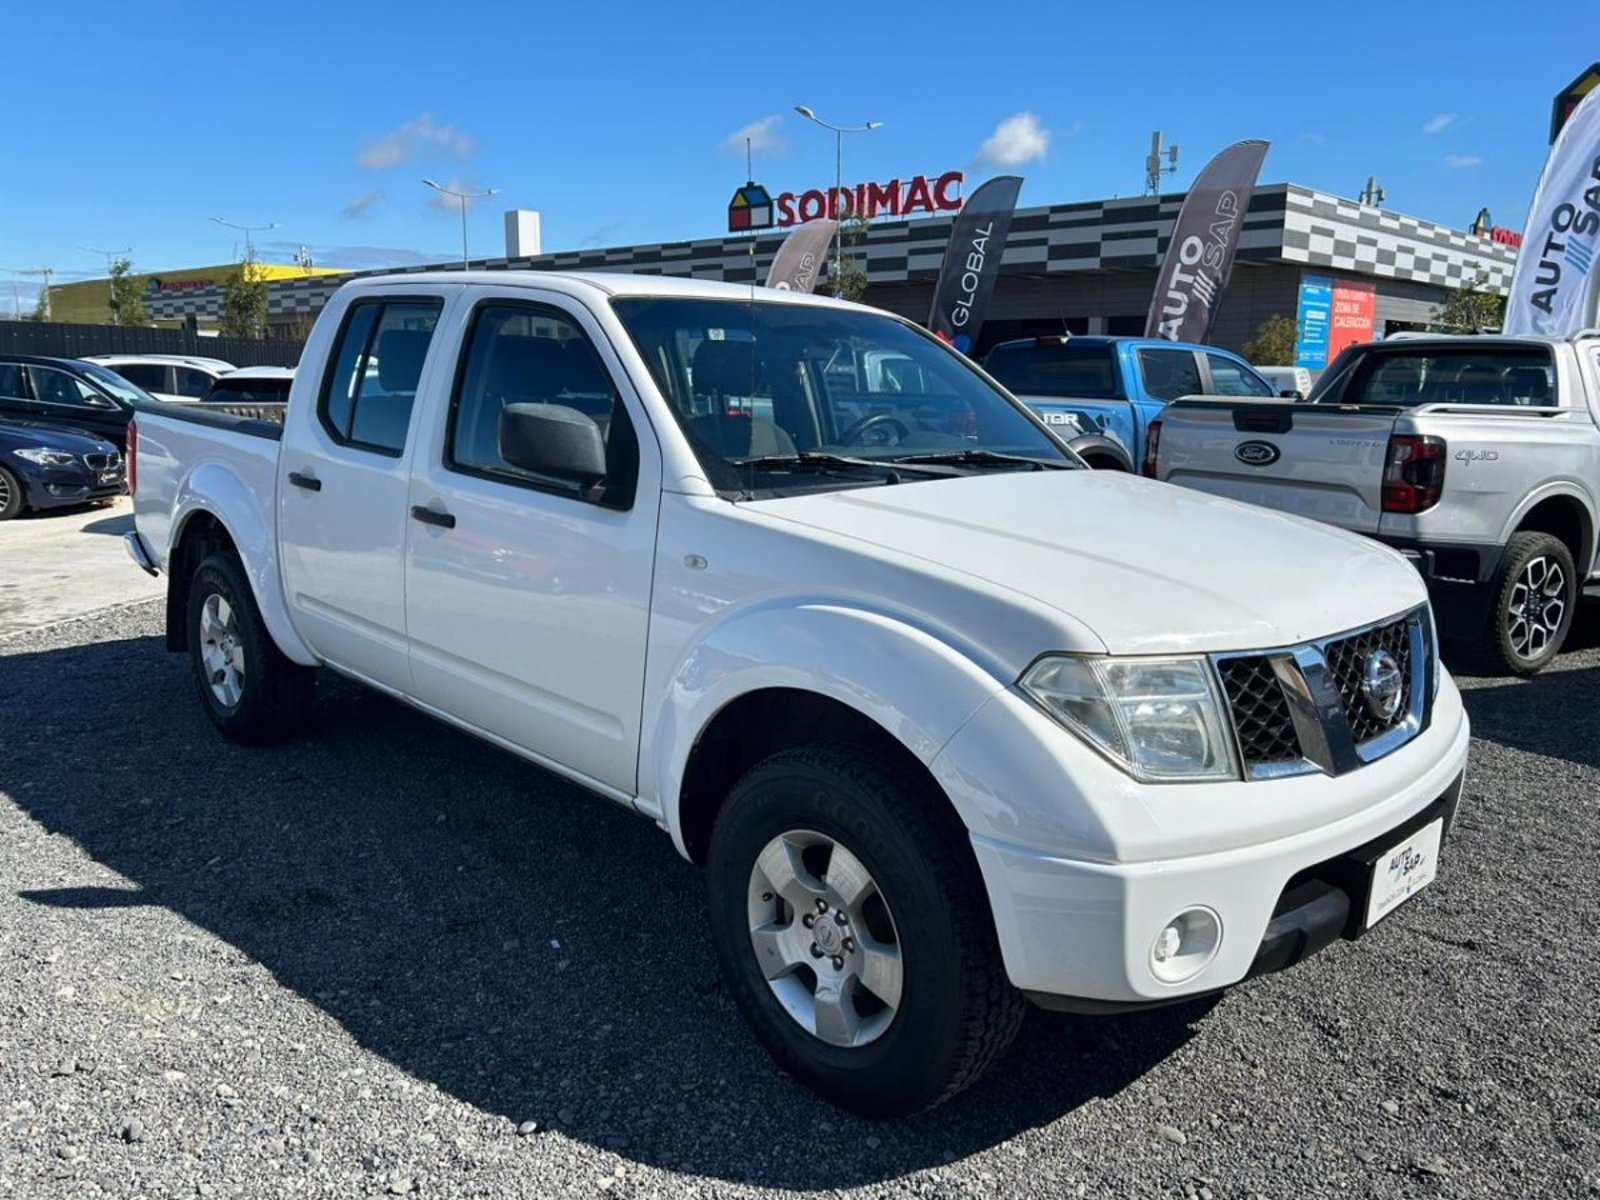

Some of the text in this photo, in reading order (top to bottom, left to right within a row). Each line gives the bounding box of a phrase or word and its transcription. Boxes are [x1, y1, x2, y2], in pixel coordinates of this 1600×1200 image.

[778, 172, 963, 227] SODIMAC
[1202, 190, 1238, 270] SAP
[793, 252, 815, 291] AP
[951, 222, 993, 327] GLOBAL
[1158, 235, 1204, 342] AUTO
[1531, 202, 1576, 315] AUTO
